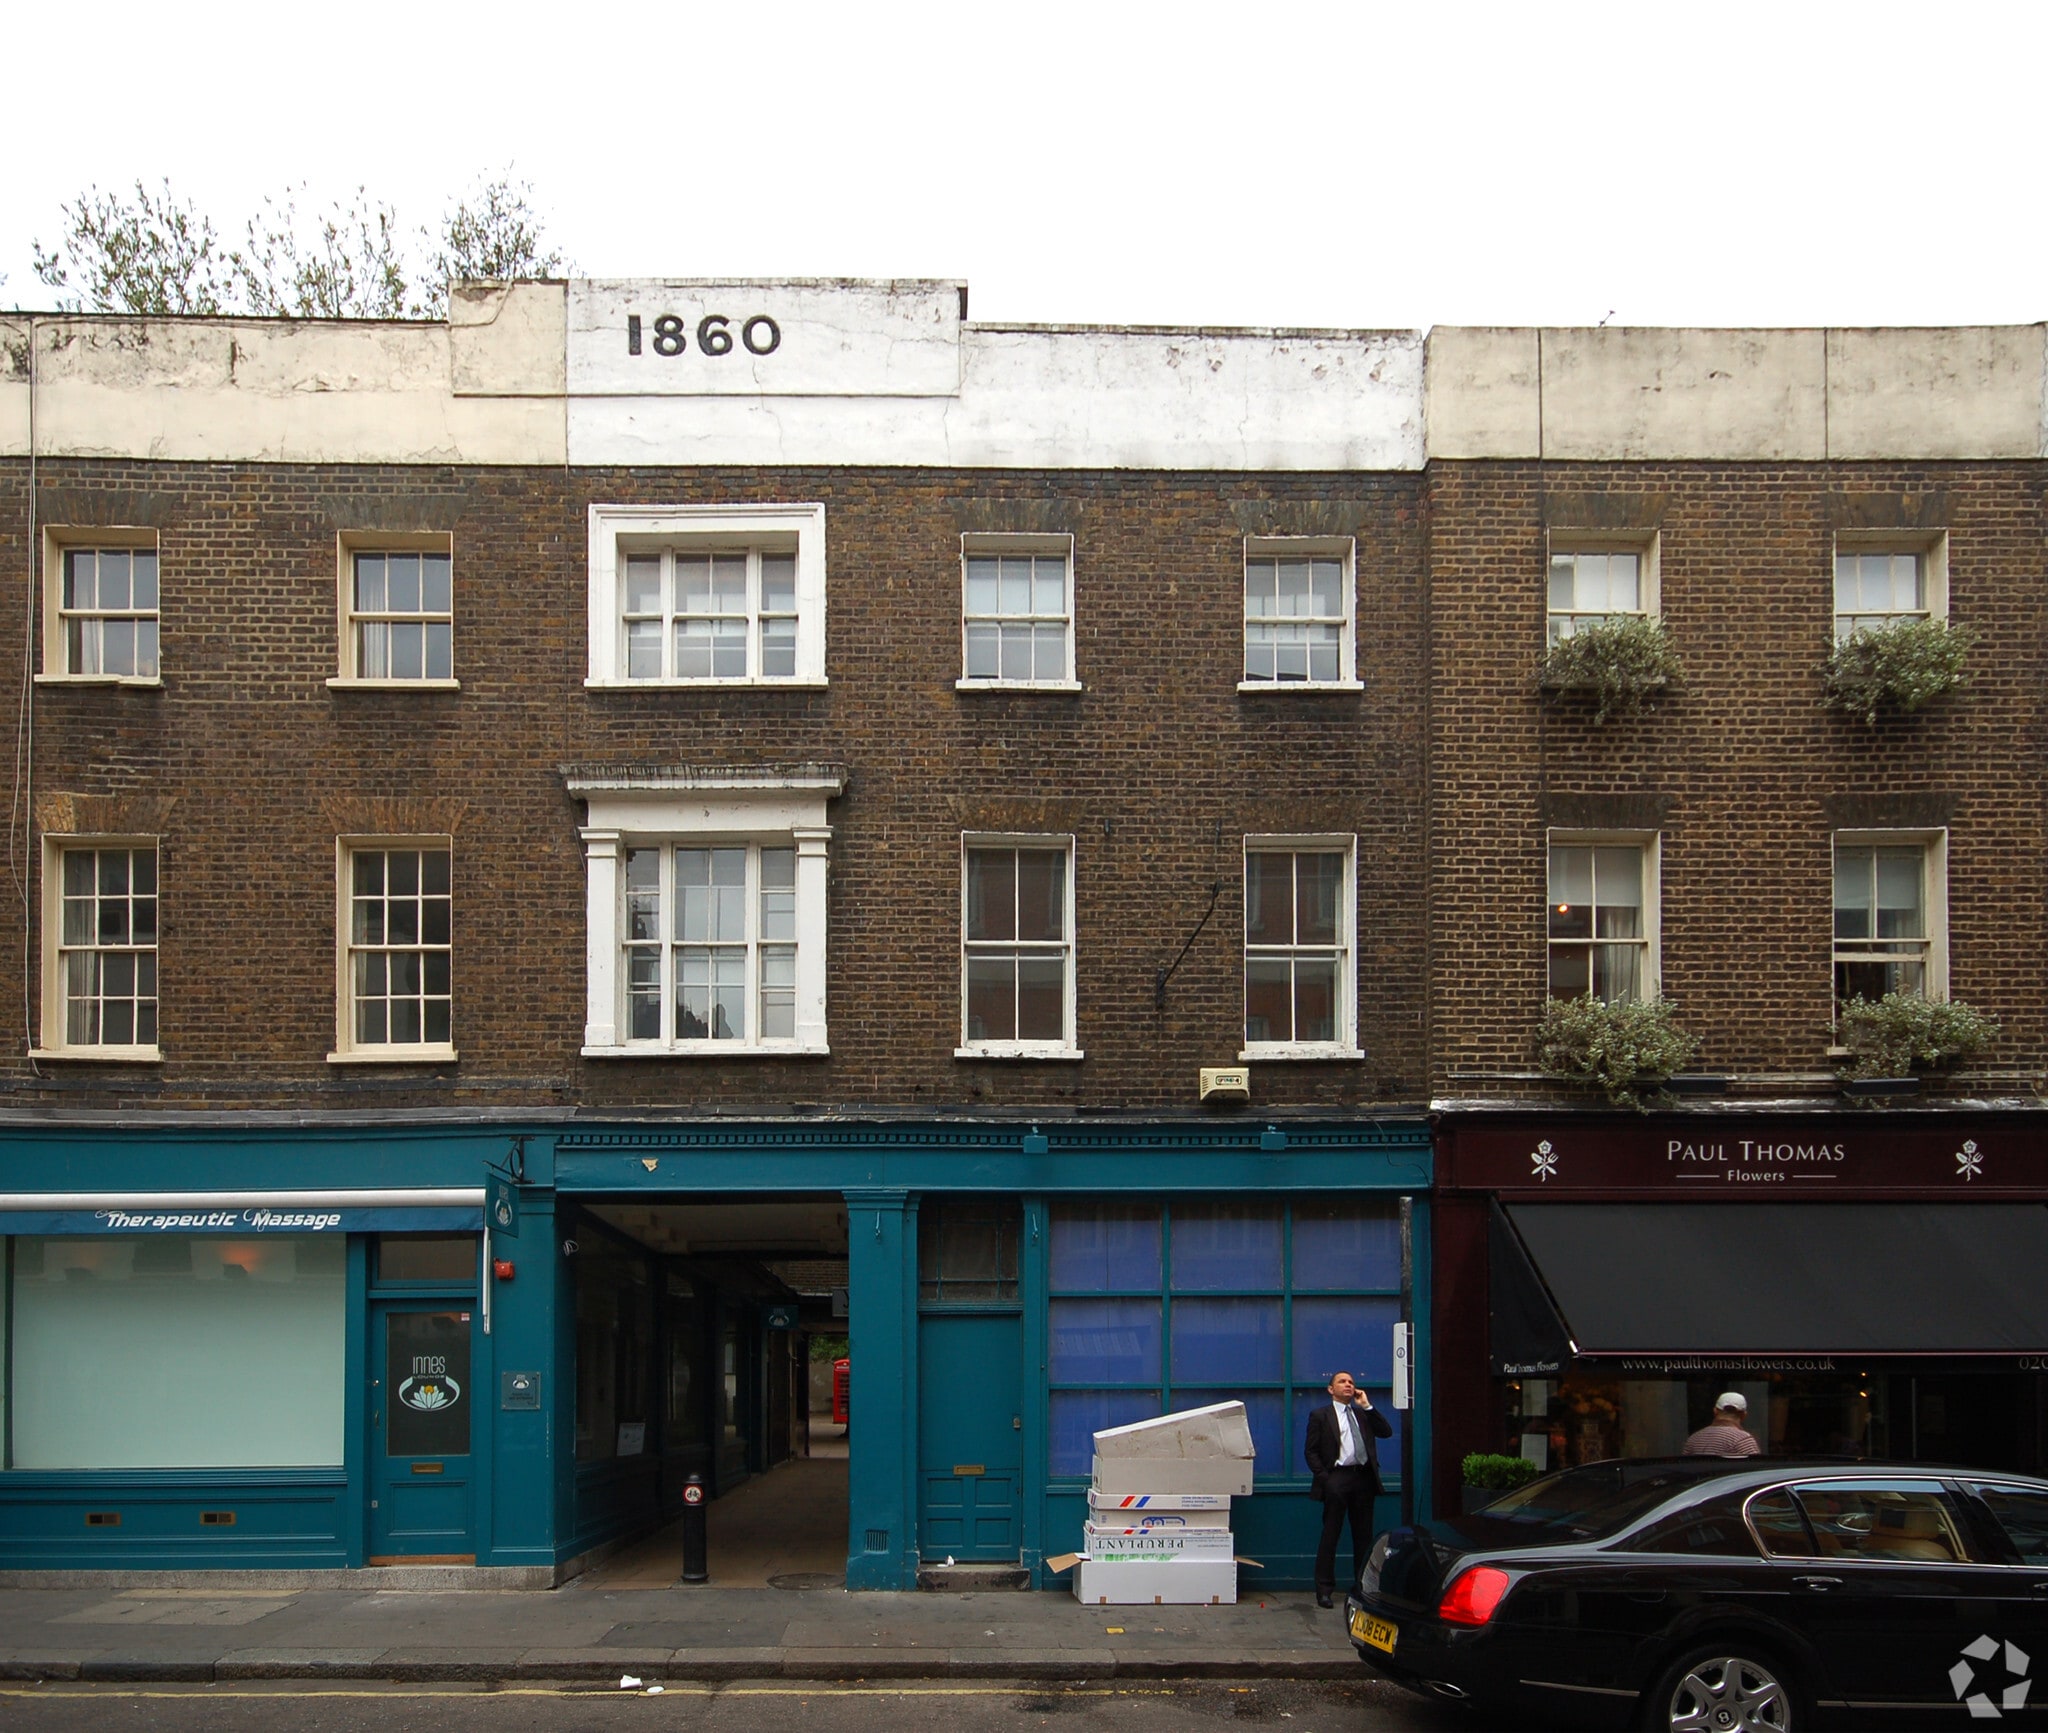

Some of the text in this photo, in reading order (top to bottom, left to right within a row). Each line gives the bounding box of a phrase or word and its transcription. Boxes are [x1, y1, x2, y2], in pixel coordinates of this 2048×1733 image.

[628, 314, 781, 356] 1860
[1667, 1140, 1845, 1162] PAUL THOMAS
[1727, 1169, 1785, 1182] Flowers
[95, 1208, 341, 1232] Therapeutic Massage
[1095, 1539, 1184, 1550] PERUPLANT
